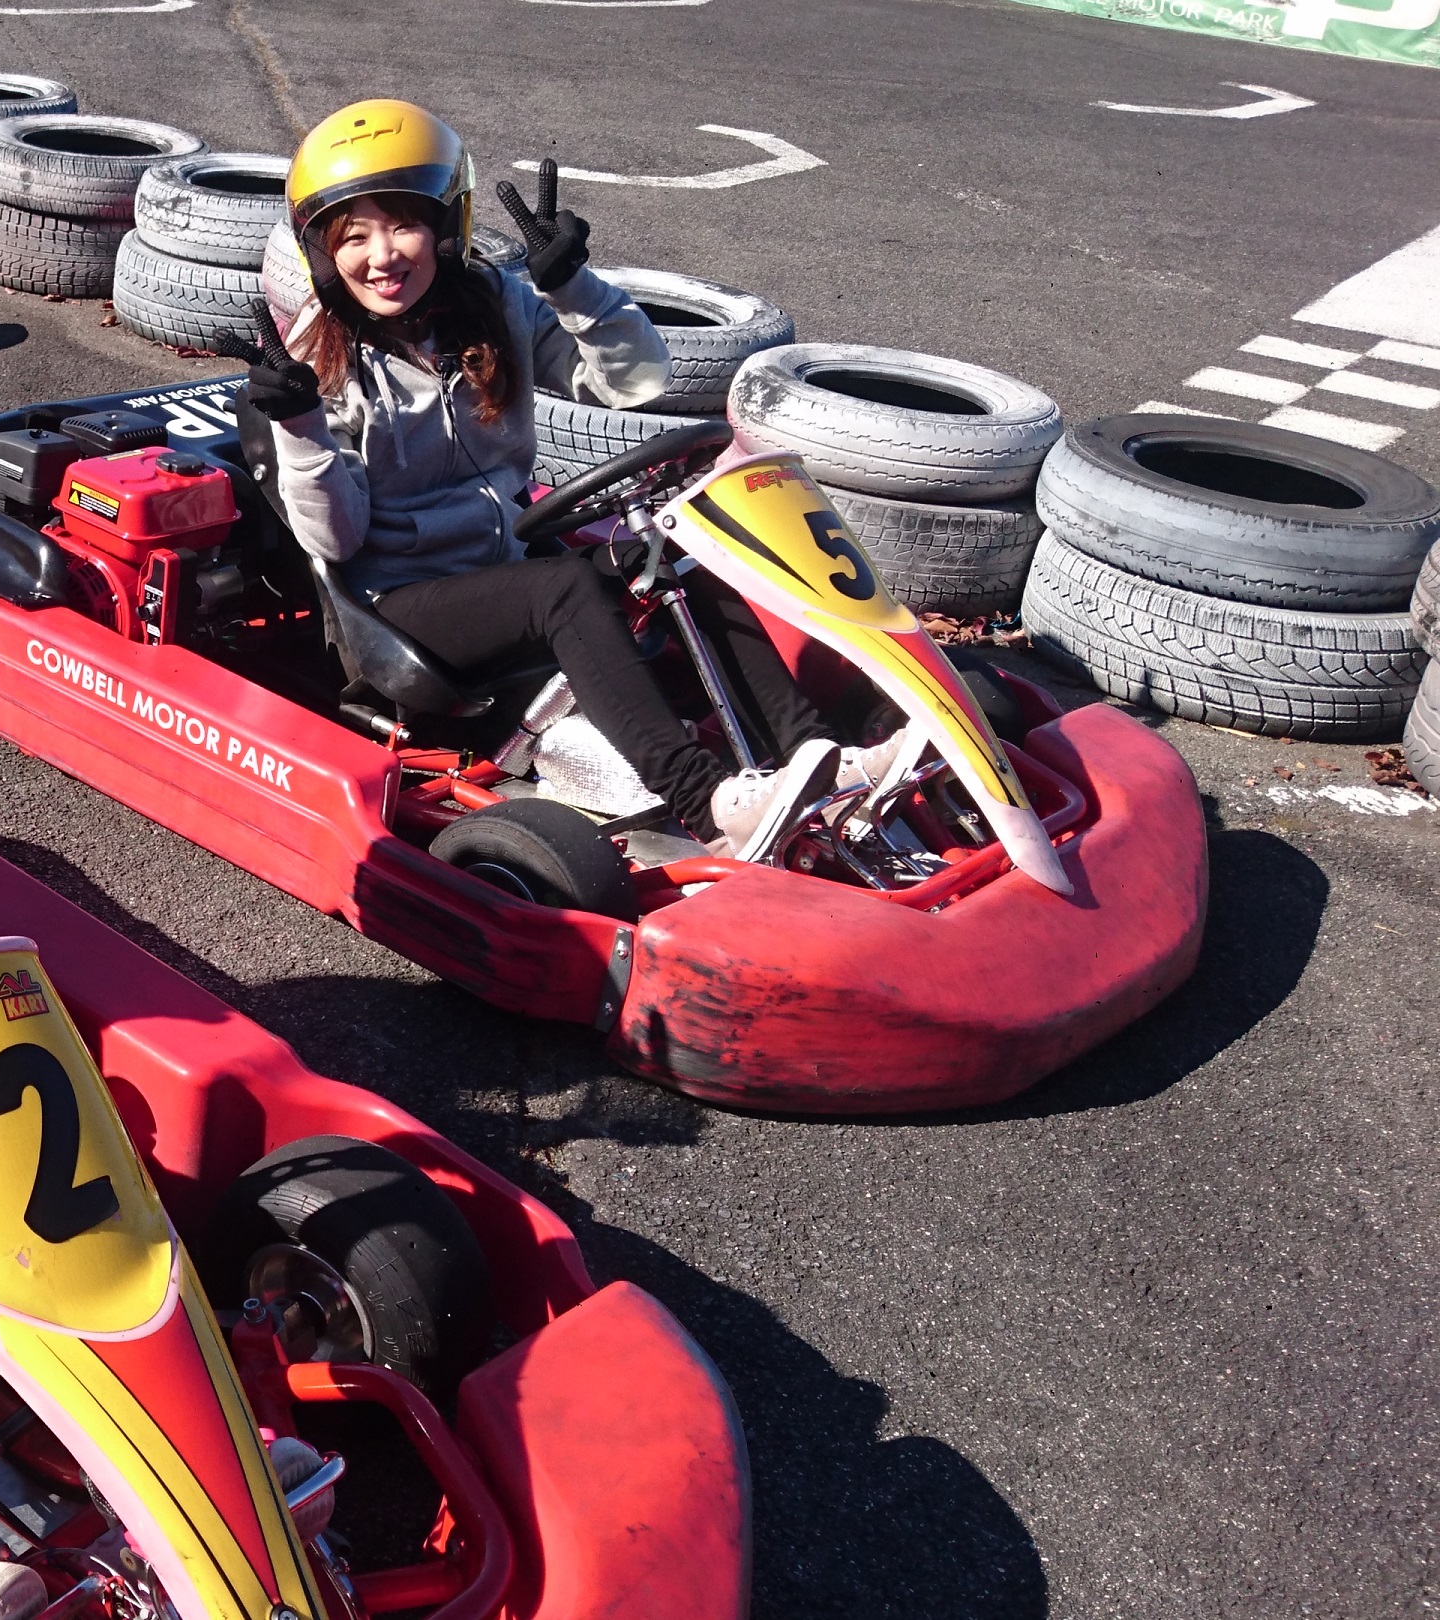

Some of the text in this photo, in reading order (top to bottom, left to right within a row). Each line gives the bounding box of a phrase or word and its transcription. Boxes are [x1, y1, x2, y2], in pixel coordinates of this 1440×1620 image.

[1213, 7, 1279, 31] PARK
[123, 394, 170, 409] PARK
[168, 383, 226, 400] MOTOR
[803, 510, 876, 601] 5
[26, 639, 294, 792] COWBELL MOTOR PARK
[3, 993, 49, 1021] KART
